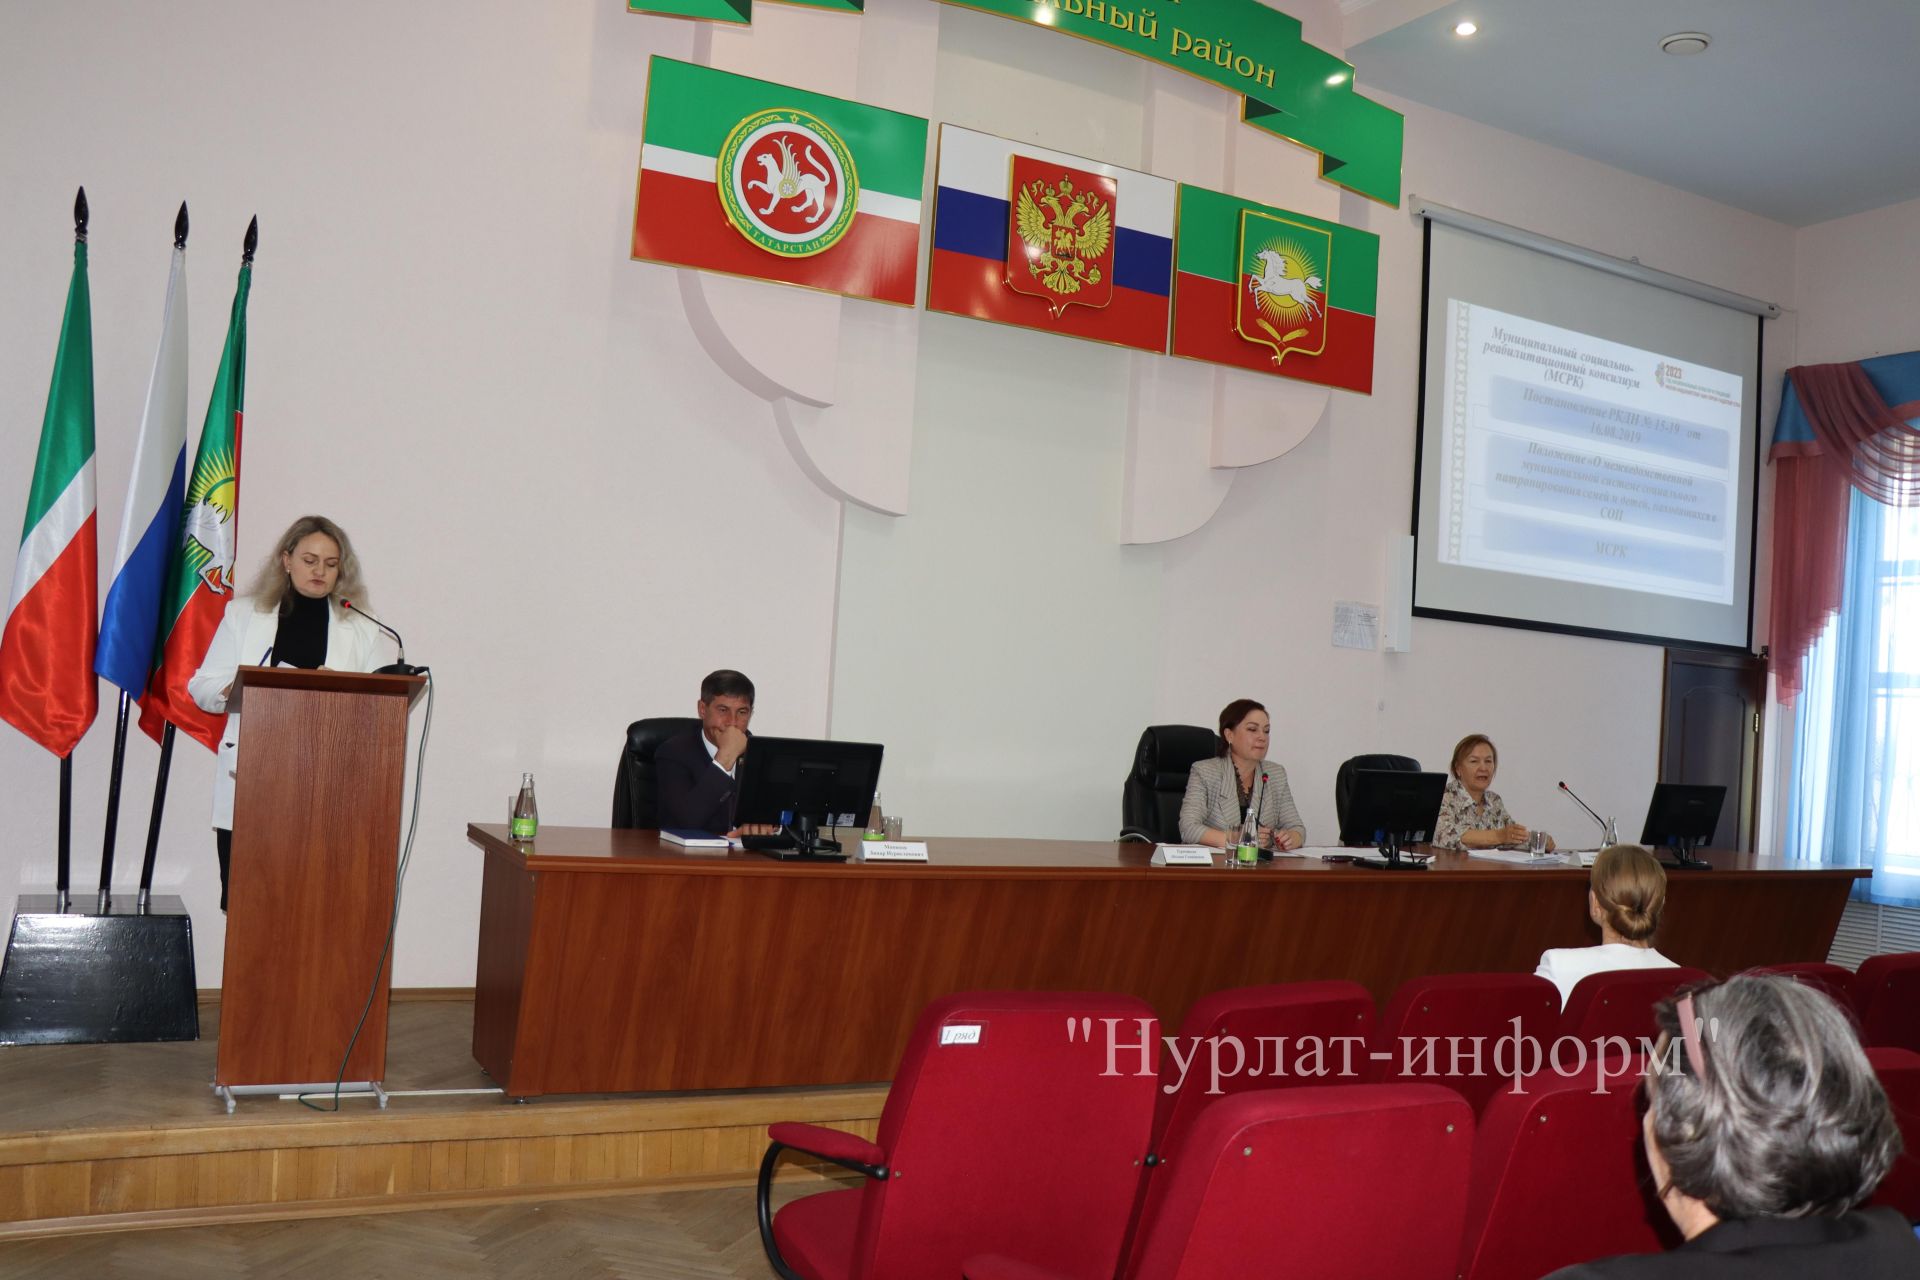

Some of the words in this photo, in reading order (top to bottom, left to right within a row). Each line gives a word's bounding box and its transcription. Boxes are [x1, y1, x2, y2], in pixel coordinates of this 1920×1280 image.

[1170, 27, 1276, 89] район
[752, 230, 820, 253] ТАТАРСТАН
[1491, 326, 1578, 360] Муниципальный
[1580, 351, 1634, 373] социально-
[1482, 341, 1586, 376] реабилитационный
[1588, 368, 1641, 390] консилиум
[1543, 368, 1584, 390] (МСРК)
[1665, 364, 1683, 380] 2023
[1522, 387, 1607, 417] Постановление
[1527, 441, 1586, 465] Положение
